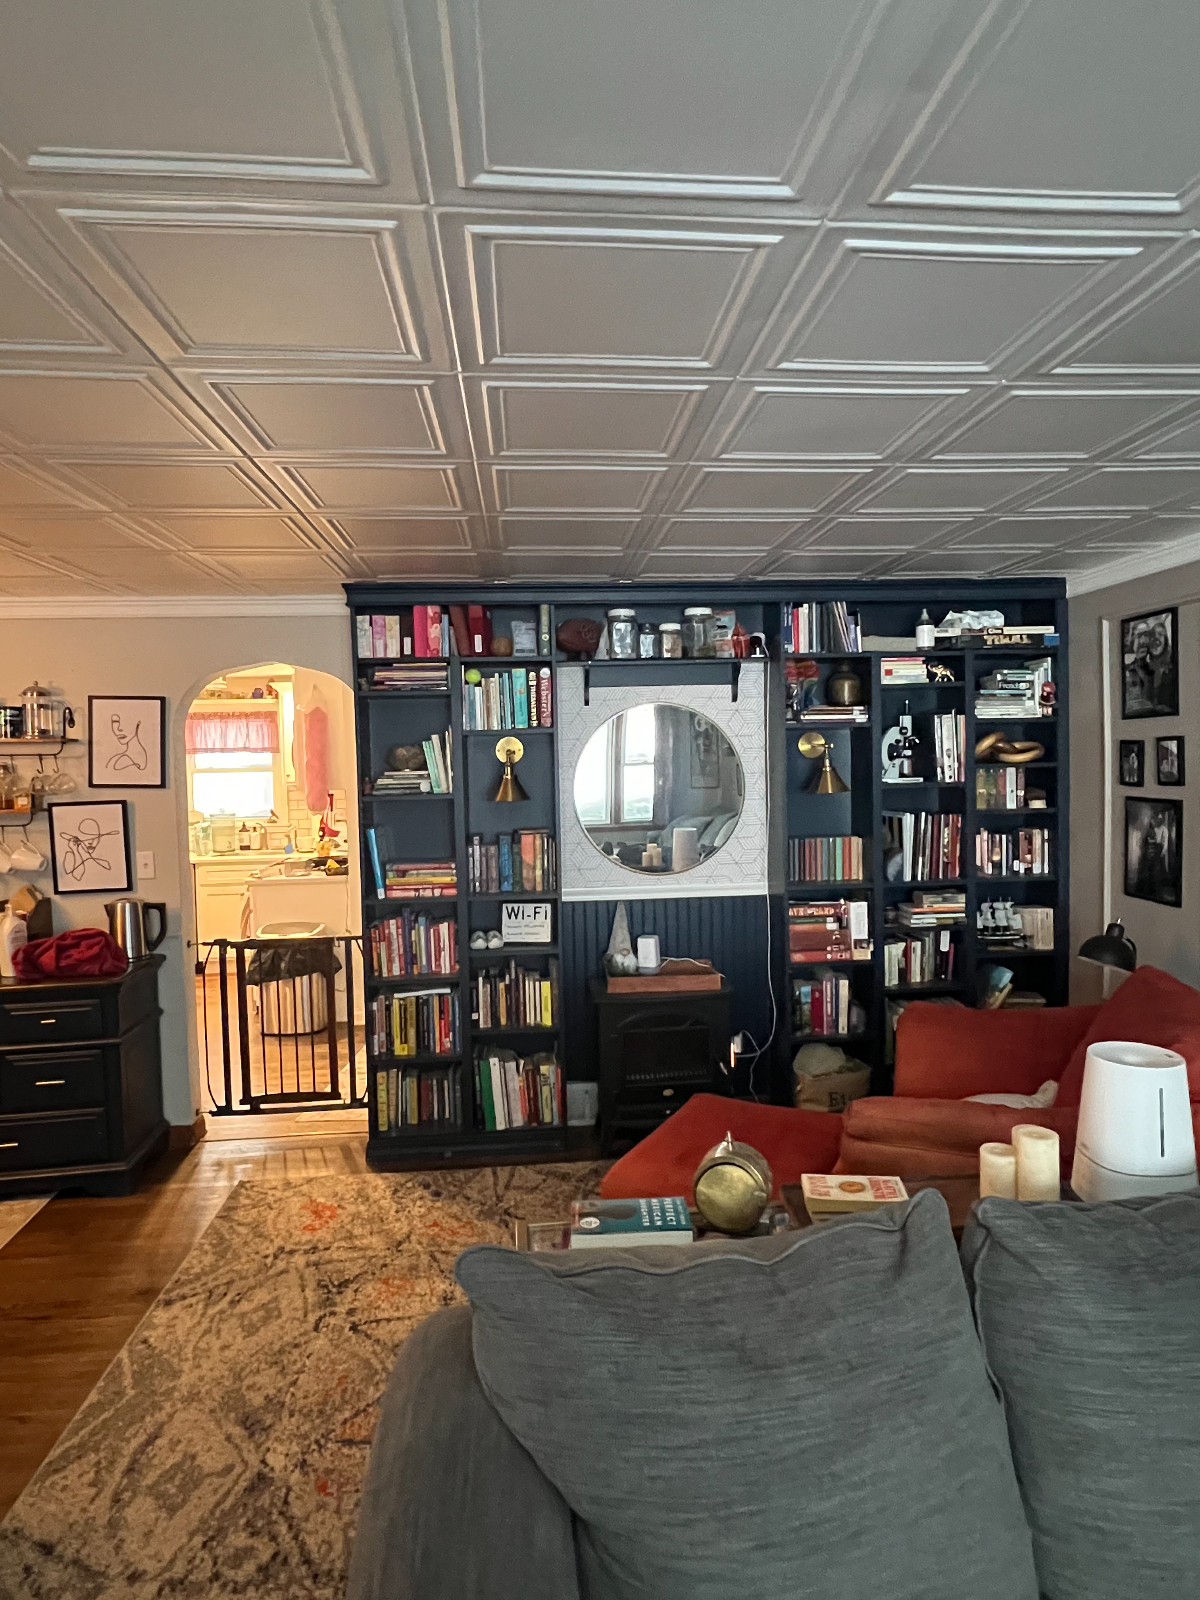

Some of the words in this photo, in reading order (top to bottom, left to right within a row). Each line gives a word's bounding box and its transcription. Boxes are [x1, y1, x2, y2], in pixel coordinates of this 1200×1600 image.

[540, 678, 549, 717] Webster's
[505, 905, 548, 920] Wi-Fi
[663, 1198, 677, 1225] PERFECT
